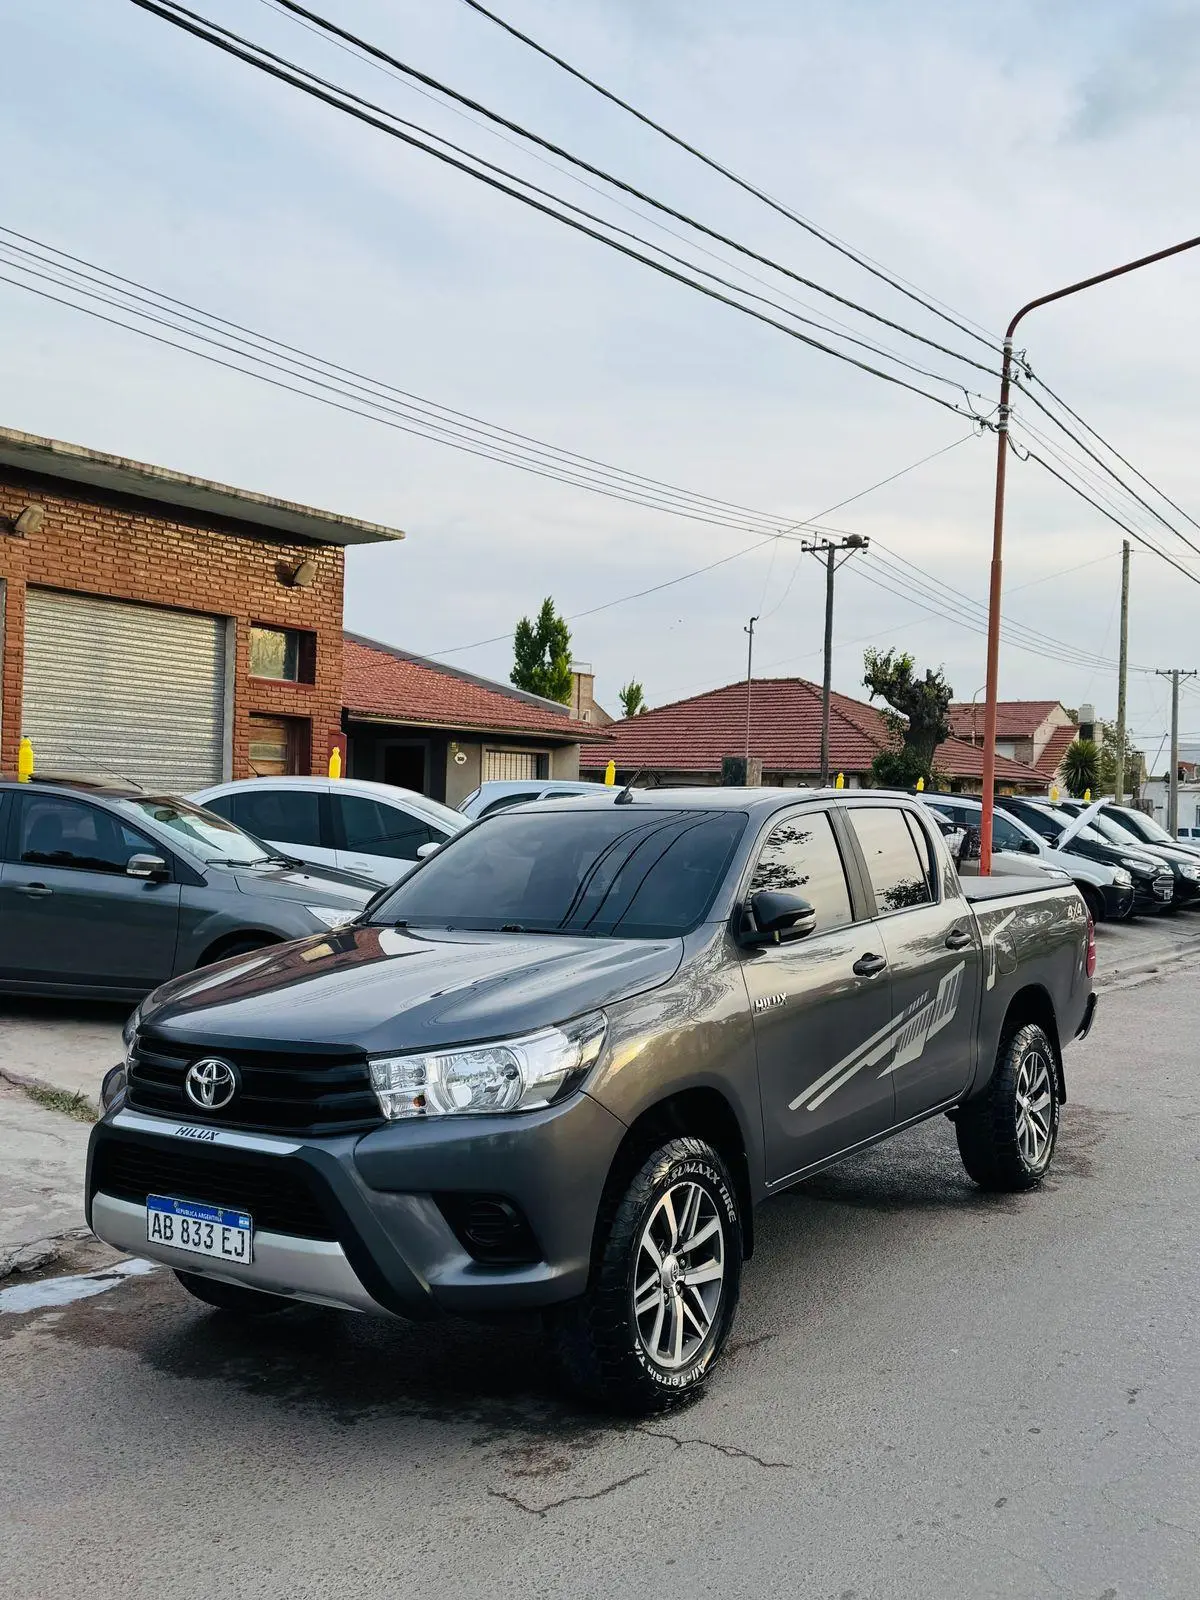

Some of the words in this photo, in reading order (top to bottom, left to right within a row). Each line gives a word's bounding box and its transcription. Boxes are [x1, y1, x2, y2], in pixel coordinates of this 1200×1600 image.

[753, 992, 787, 1013] HILUX
[175, 1126, 220, 1141] HILUX
[719, 1182, 737, 1223] TIRE
[198, 1212, 223, 1224] ARGENTINA
[152, 1212, 174, 1241] AB
[181, 1218, 214, 1250] 833
[221, 1226, 245, 1258] EJ
[647, 1359, 705, 1388] All-Terrain
